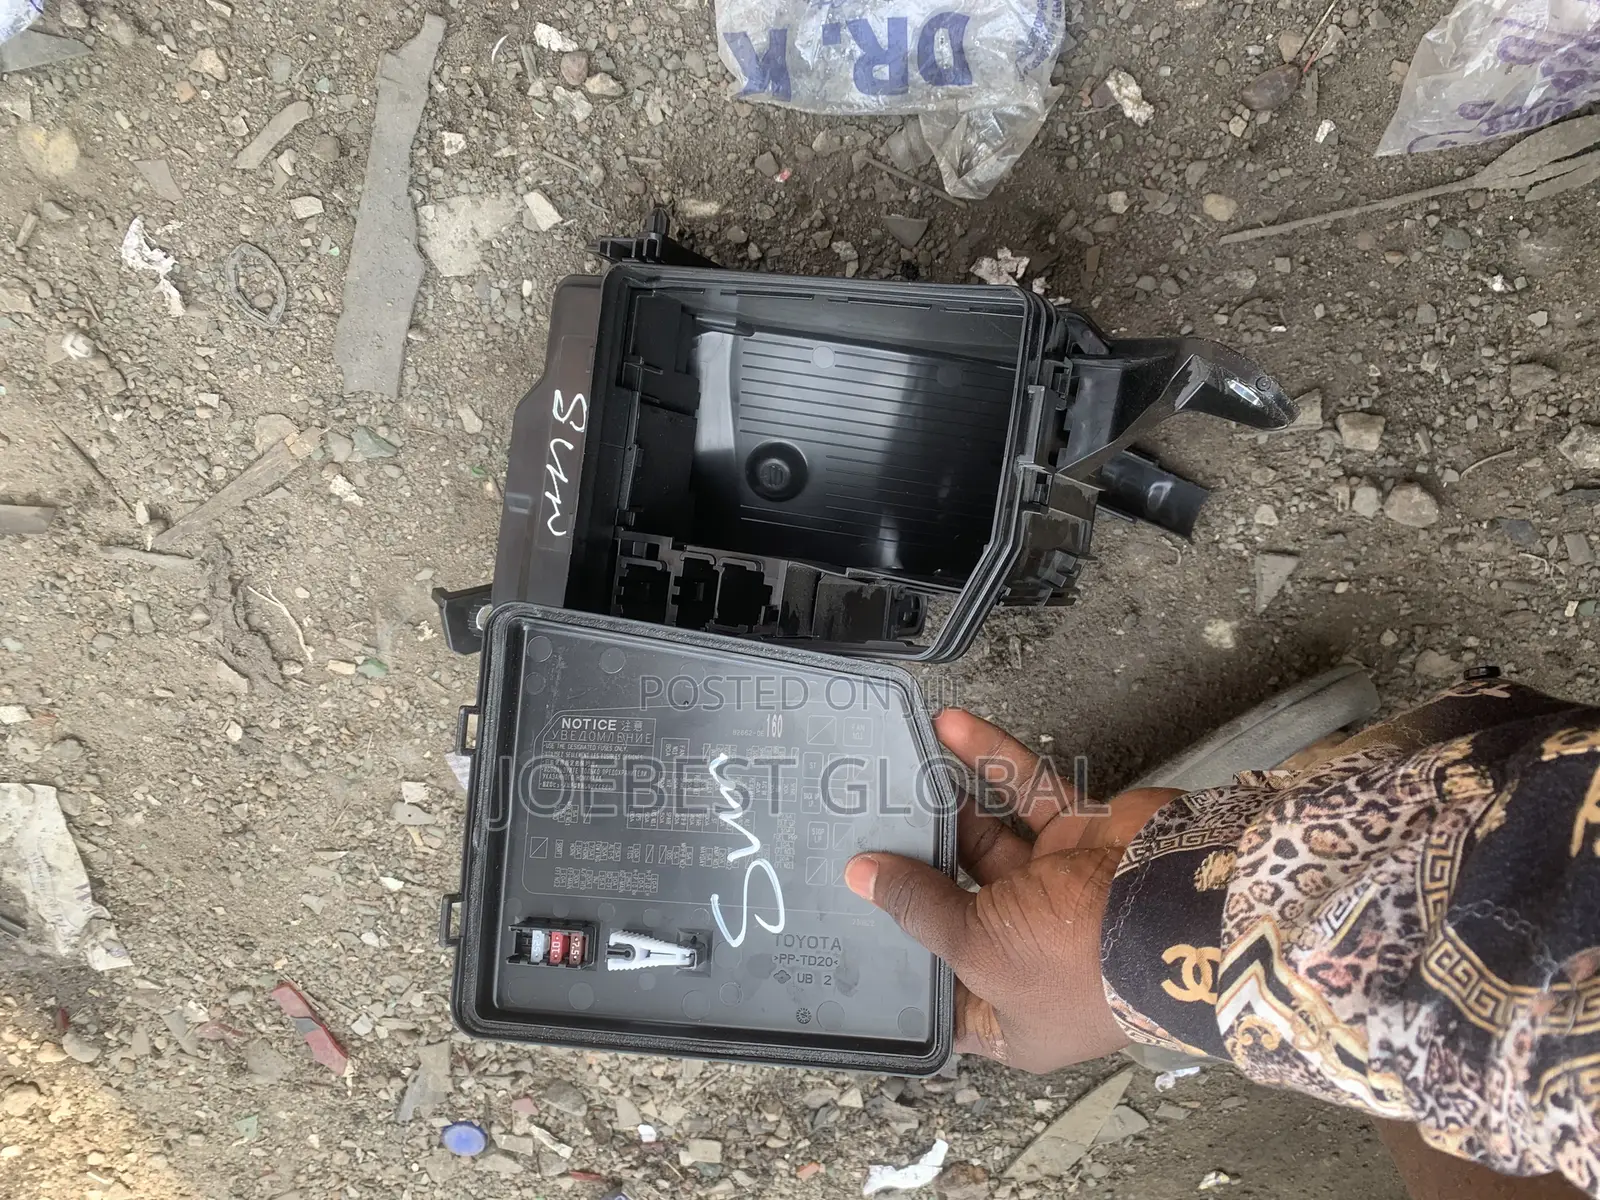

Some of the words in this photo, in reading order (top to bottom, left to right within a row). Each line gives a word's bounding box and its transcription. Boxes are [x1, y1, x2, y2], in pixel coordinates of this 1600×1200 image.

[561, 718, 617, 730] NOTICE
[766, 714, 783, 738] 160
[772, 933, 841, 951] TOYOTA
[797, 973, 813, 984] UB
[824, 975, 832, 985] 2
